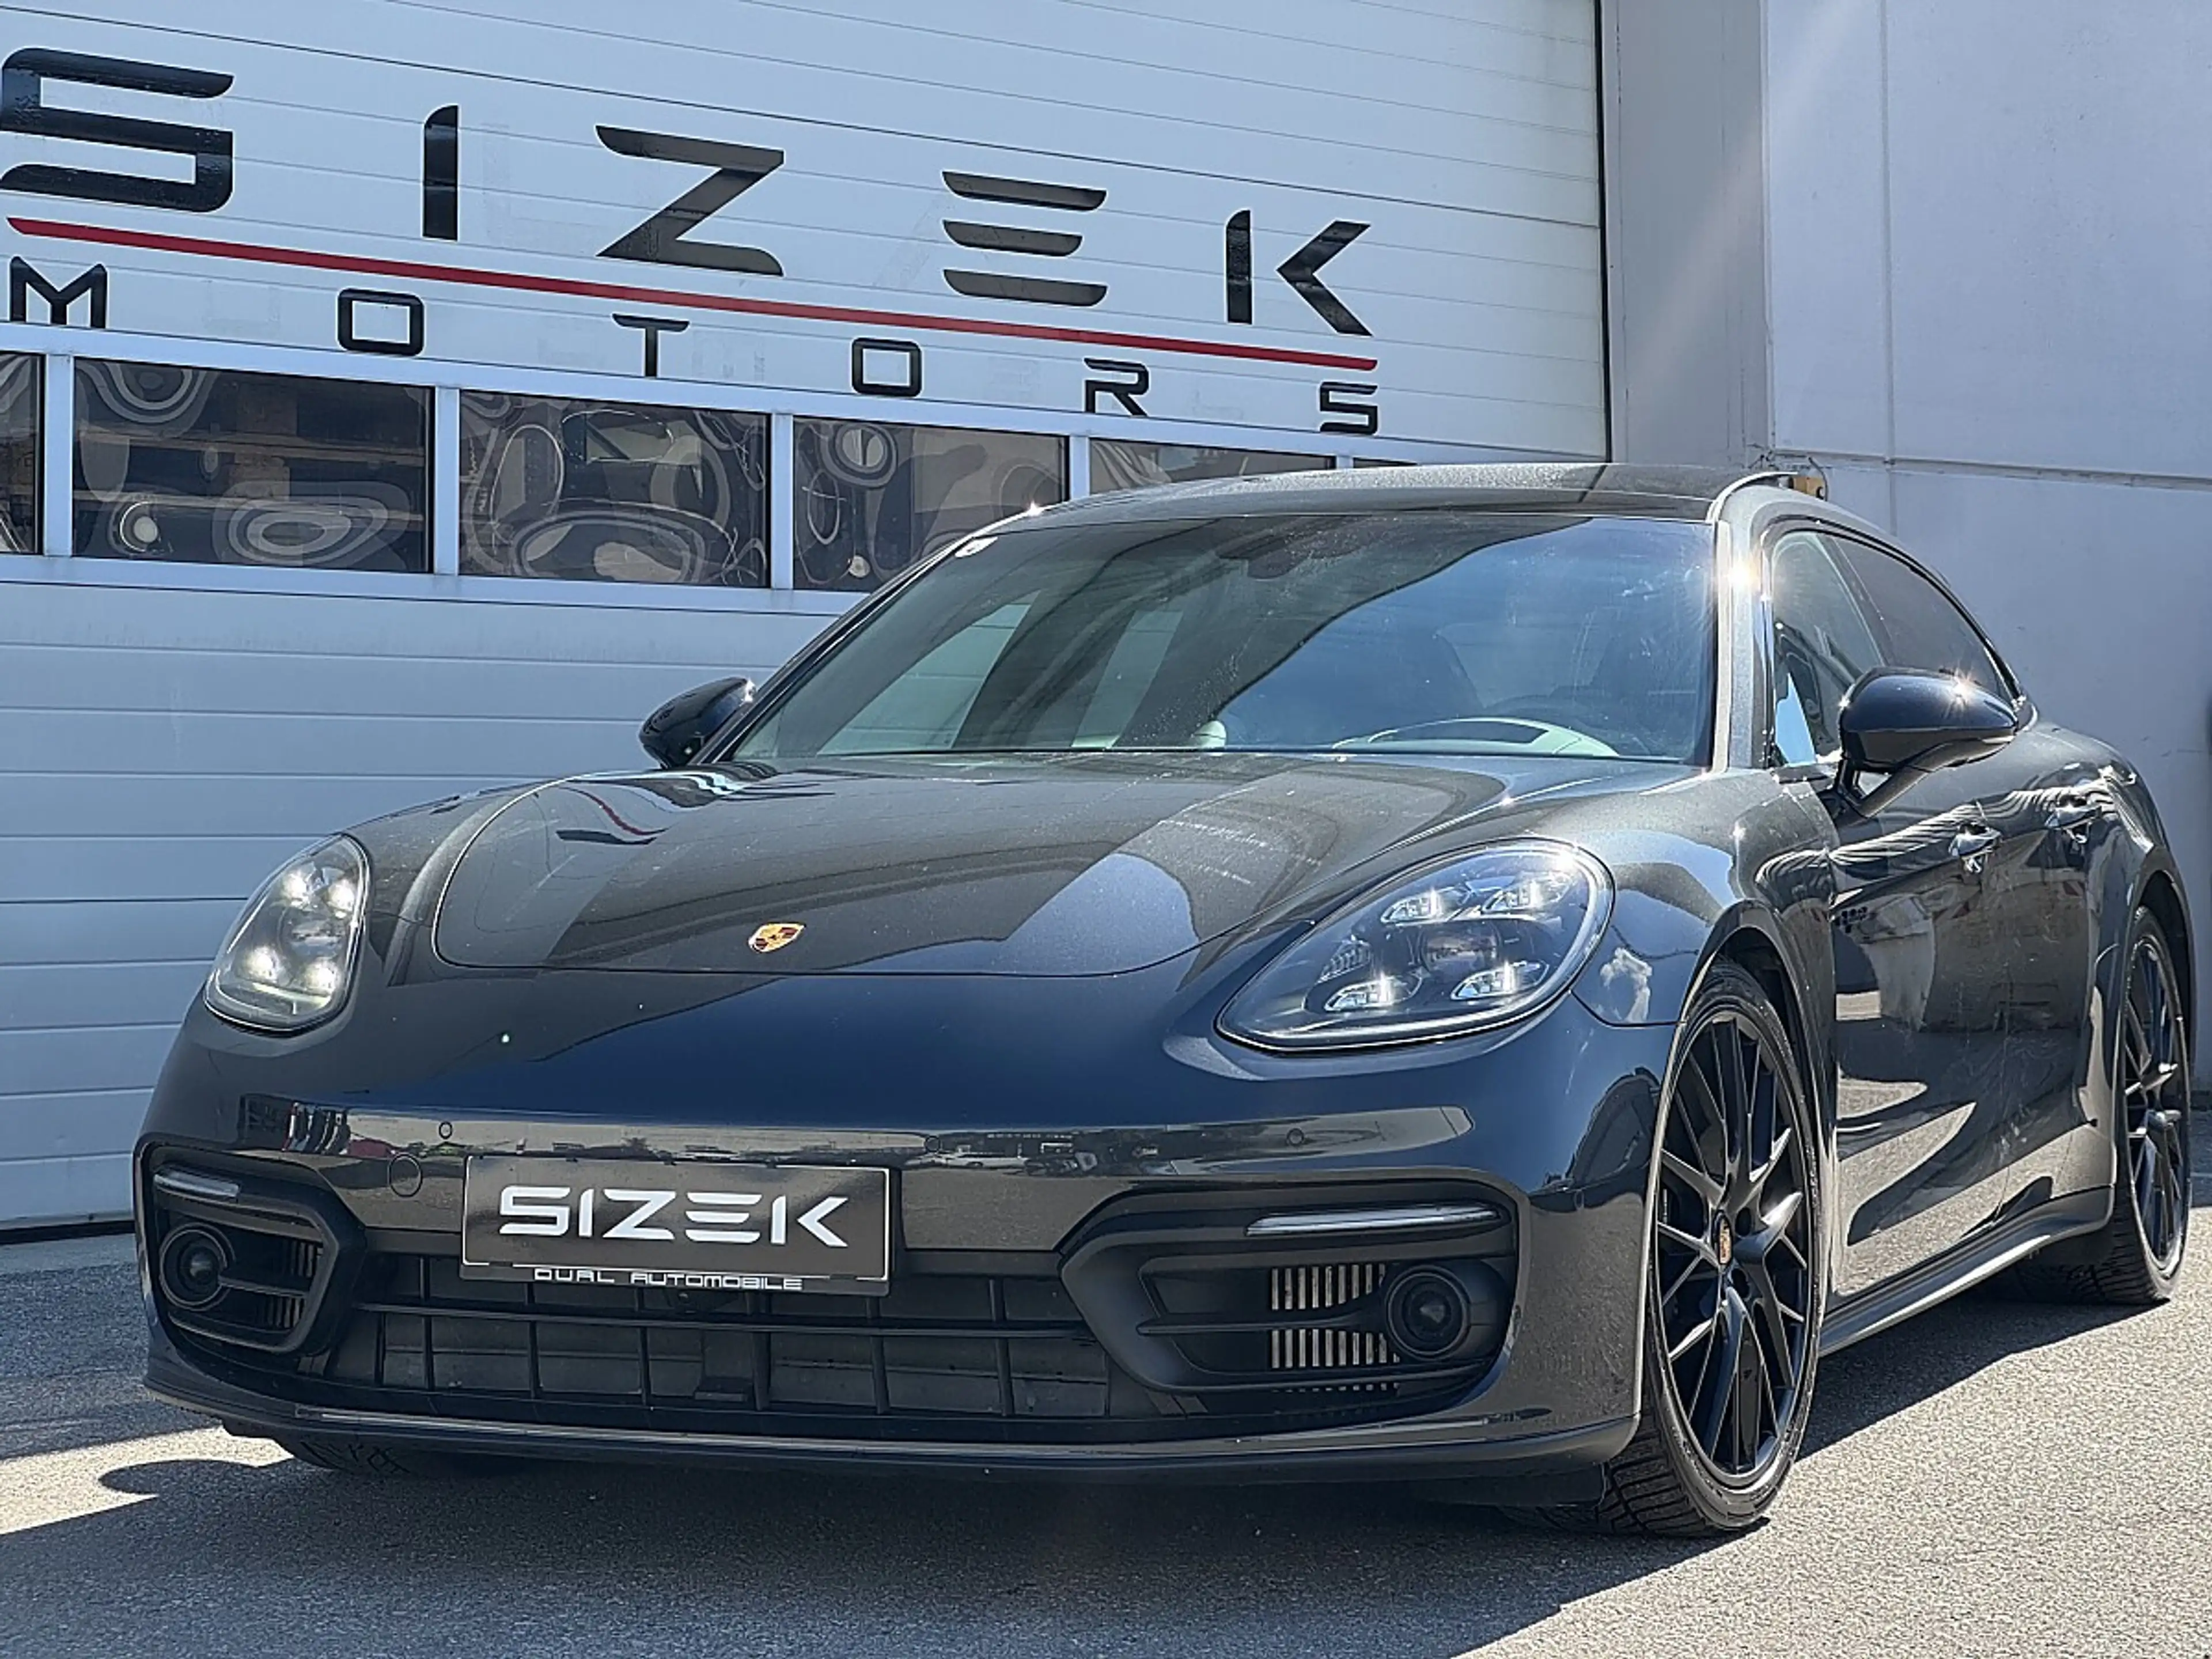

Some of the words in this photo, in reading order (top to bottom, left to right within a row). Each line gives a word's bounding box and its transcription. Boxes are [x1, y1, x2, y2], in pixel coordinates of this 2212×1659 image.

[0, 48, 1372, 336] SIZEK
[9, 256, 1378, 435] MOTORS
[499, 1185, 849, 1247] SIZEK
[535, 1268, 615, 1283] DUAL
[630, 1272, 802, 1290] AUTOMOBILE
